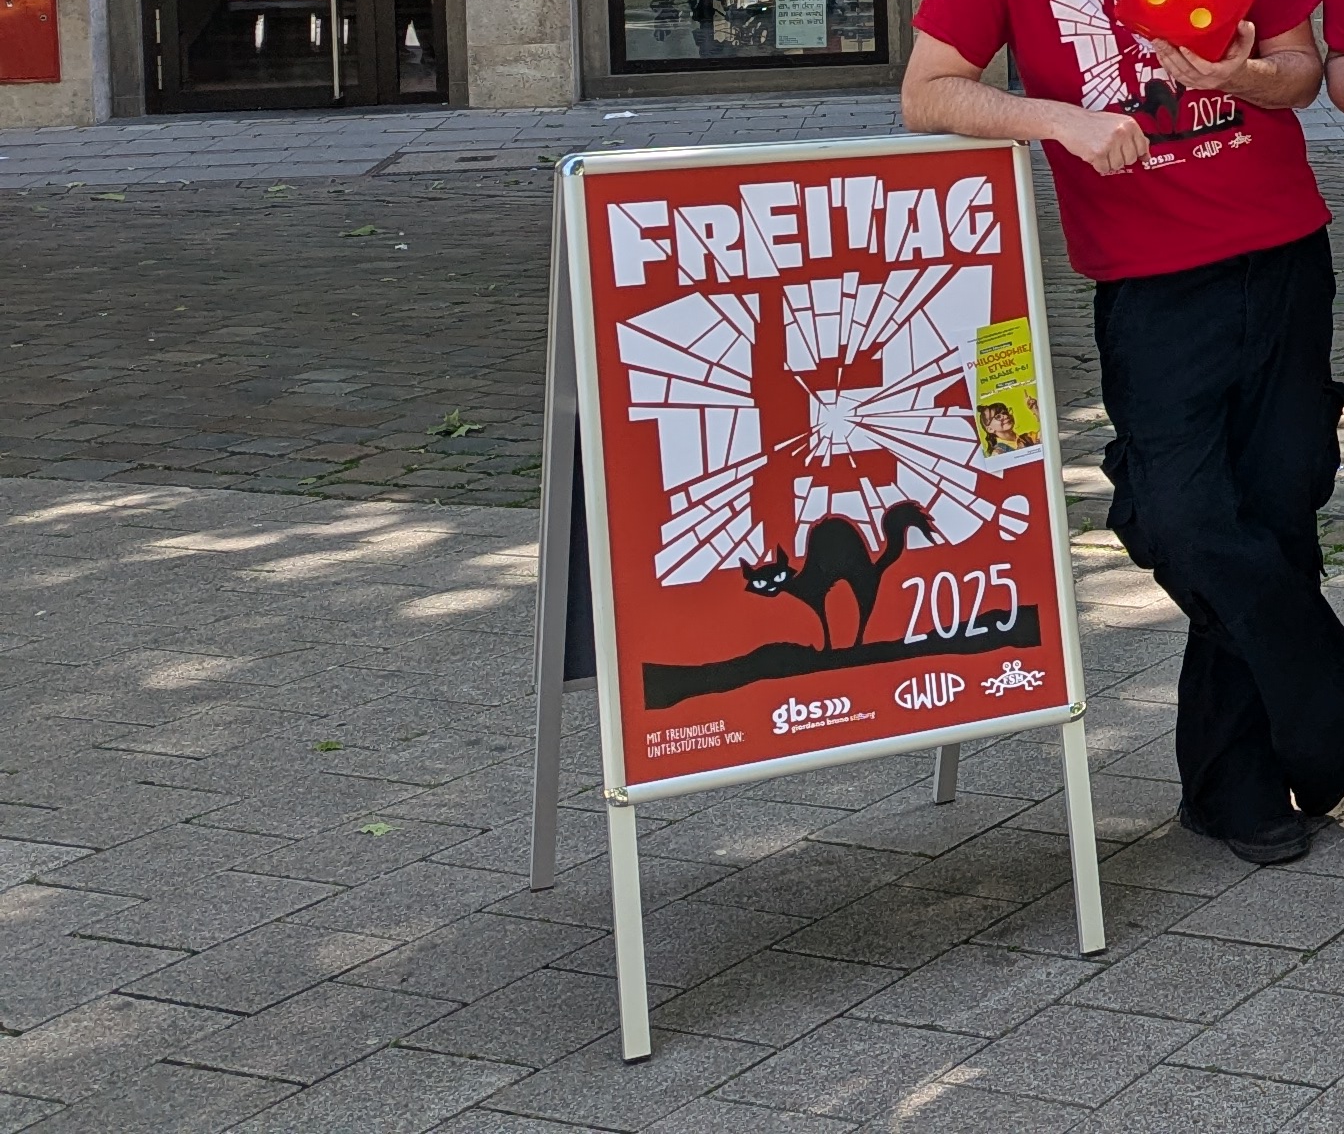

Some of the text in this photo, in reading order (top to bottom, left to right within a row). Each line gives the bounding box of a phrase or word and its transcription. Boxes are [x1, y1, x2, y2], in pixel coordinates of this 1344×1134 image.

[1188, 93, 1236, 132] 2025
[1192, 140, 1223, 159] GWUP
[607, 175, 1002, 288] FREITAG
[901, 562, 1019, 645] 2025
[894, 672, 966, 710] GWUP
[646, 719, 726, 746] MIT FREUNDLICHER
[647, 732, 745, 758] UNTERSTÜTZUNG VON:
